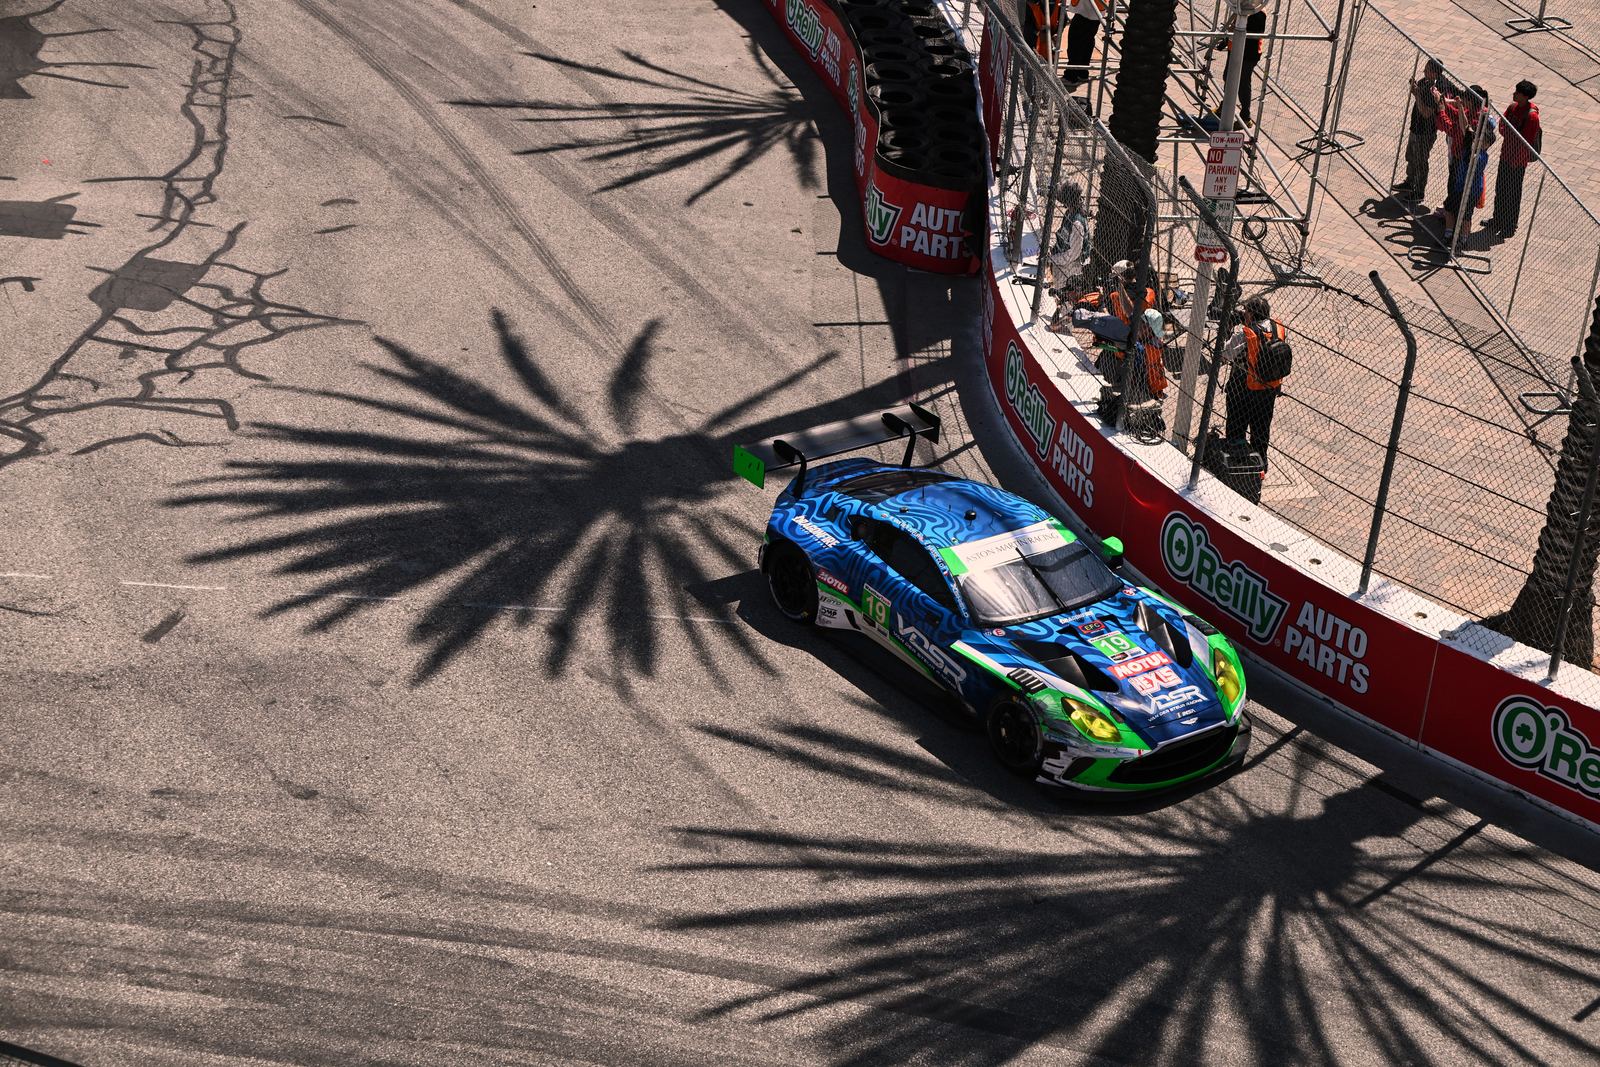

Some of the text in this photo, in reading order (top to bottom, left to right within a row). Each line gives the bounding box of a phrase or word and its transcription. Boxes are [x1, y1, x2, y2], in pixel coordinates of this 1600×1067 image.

[826, 26, 841, 62] AUTO
[821, 45, 841, 87] PARTS
[1212, 136, 1242, 145] TOW-AWAY
[1208, 166, 1237, 176] PARKING
[1209, 150, 1222, 163] NO
[1213, 184, 1227, 193] TIME
[1214, 176, 1227, 184] ANY
[900, 226, 969, 260] PART
[1006, 343, 1053, 455] O'Reilly
[1059, 421, 1094, 475] AUTO
[1053, 443, 1094, 508] PARTS
[966, 532, 1059, 562] ASTON MARTIN RACING
[818, 571, 848, 593] MOTUL
[1163, 515, 1286, 638] O'Reilly
[866, 594, 886, 624] 19
[1100, 636, 1130, 653] 19
[1296, 601, 1368, 659] AUTO
[897, 611, 967, 696] VDSR
[1114, 652, 1170, 678] MOTUL
[1283, 630, 1370, 695] PARTS
[1129, 666, 1182, 695] HEXIS
[1139, 685, 1209, 714] VDSR
